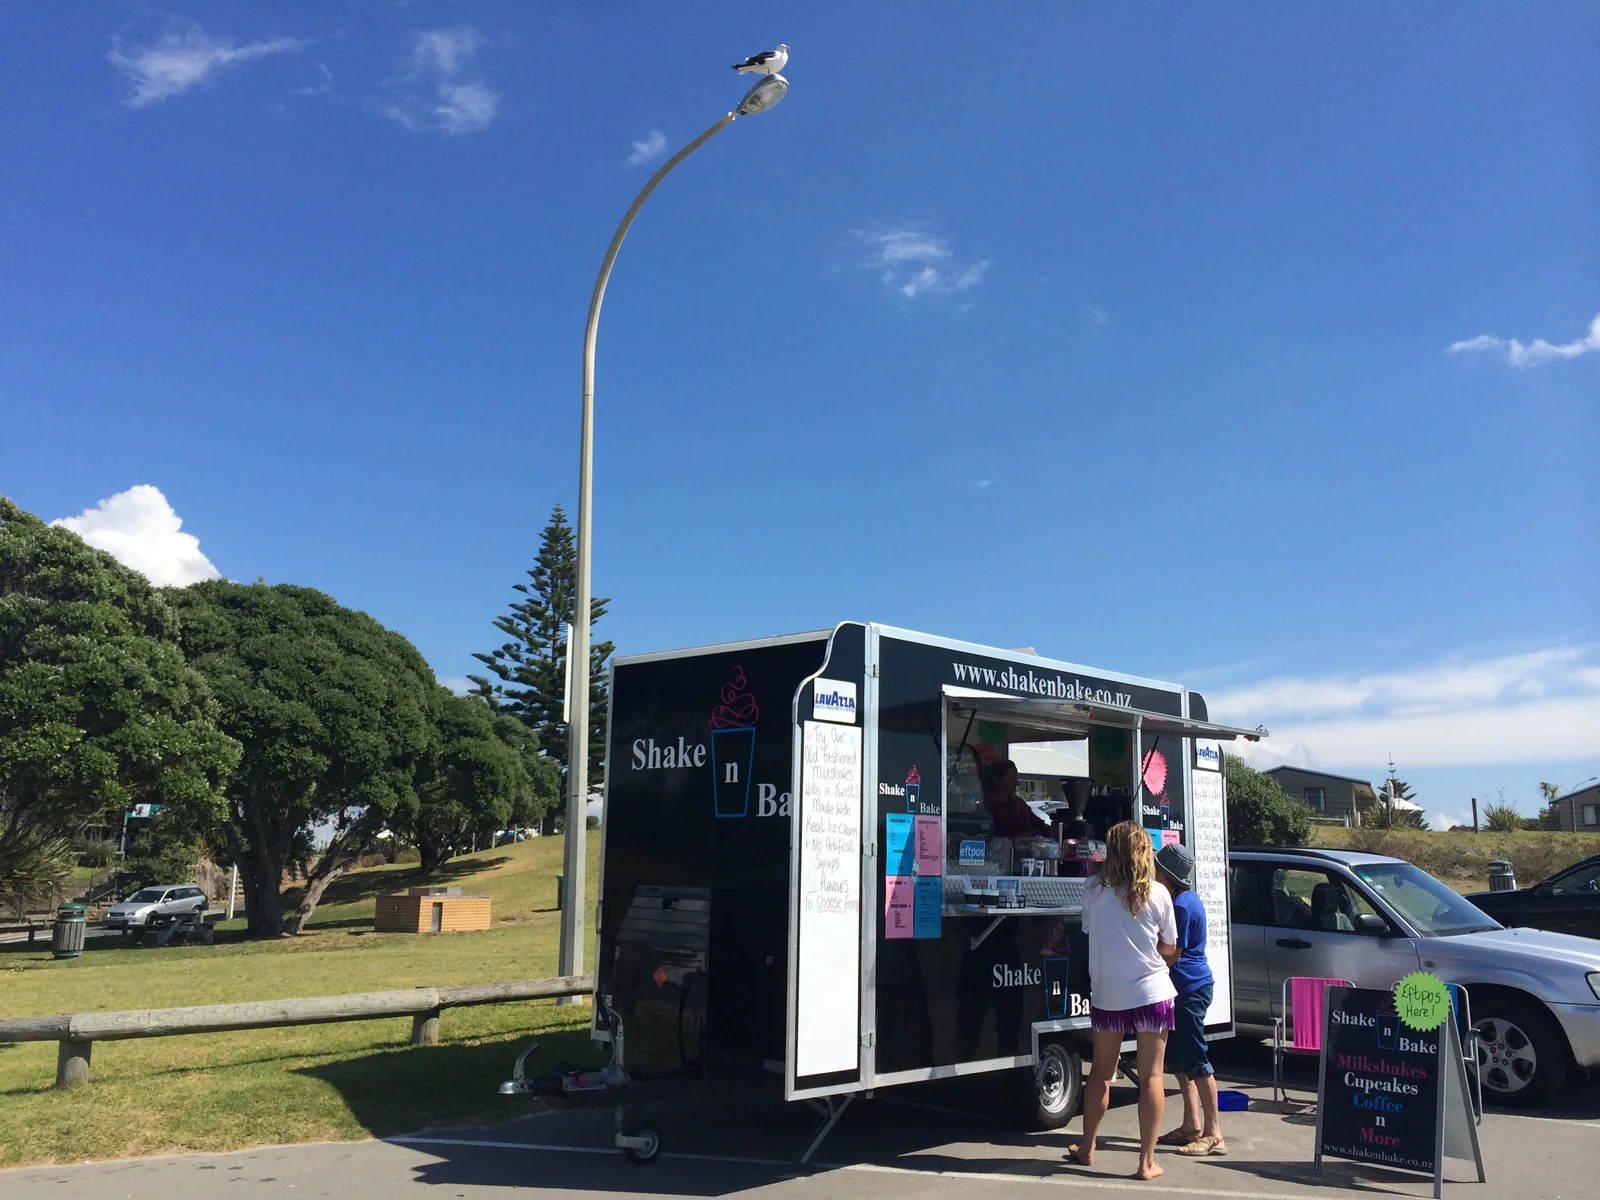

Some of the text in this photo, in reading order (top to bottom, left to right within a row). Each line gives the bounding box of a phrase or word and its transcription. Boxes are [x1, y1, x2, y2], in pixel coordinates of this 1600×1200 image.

[952, 662, 1132, 708] www.shakenbake.co.nz
[815, 690, 855, 709] LAVAZZA
[812, 724, 846, 751] Try Our
[632, 736, 707, 770] Shake
[724, 761, 739, 783] n
[805, 745, 818, 763] Old
[1196, 746, 1218, 760] LAVAZZA
[824, 786, 831, 796] a
[879, 782, 940, 814] Shake n Bake
[812, 798, 833, 815] Made
[805, 814, 826, 833] Real
[1142, 804, 1160, 816] Shake
[1169, 820, 1184, 831] Bake
[812, 837, 822, 852] No
[960, 844, 984, 860] eftpos
[815, 853, 840, 875] Syrups
[803, 893, 812, 910] To
[816, 893, 842, 909] Choose
[992, 963, 1093, 1016] Shake n Ba
[1401, 982, 1441, 1006] Eftpos
[1405, 1004, 1435, 1019] Here!
[1332, 1010, 1437, 1054] Shake n Bake
[1337, 1054, 1427, 1079] Milkshakes
[1344, 1071, 1419, 1095] Cupcakes
[1353, 1092, 1404, 1113] Coffee
[1375, 1115, 1386, 1127] n
[1360, 1127, 1401, 1147] More
[1323, 1144, 1434, 1169] www.shakenbake.co.nz
